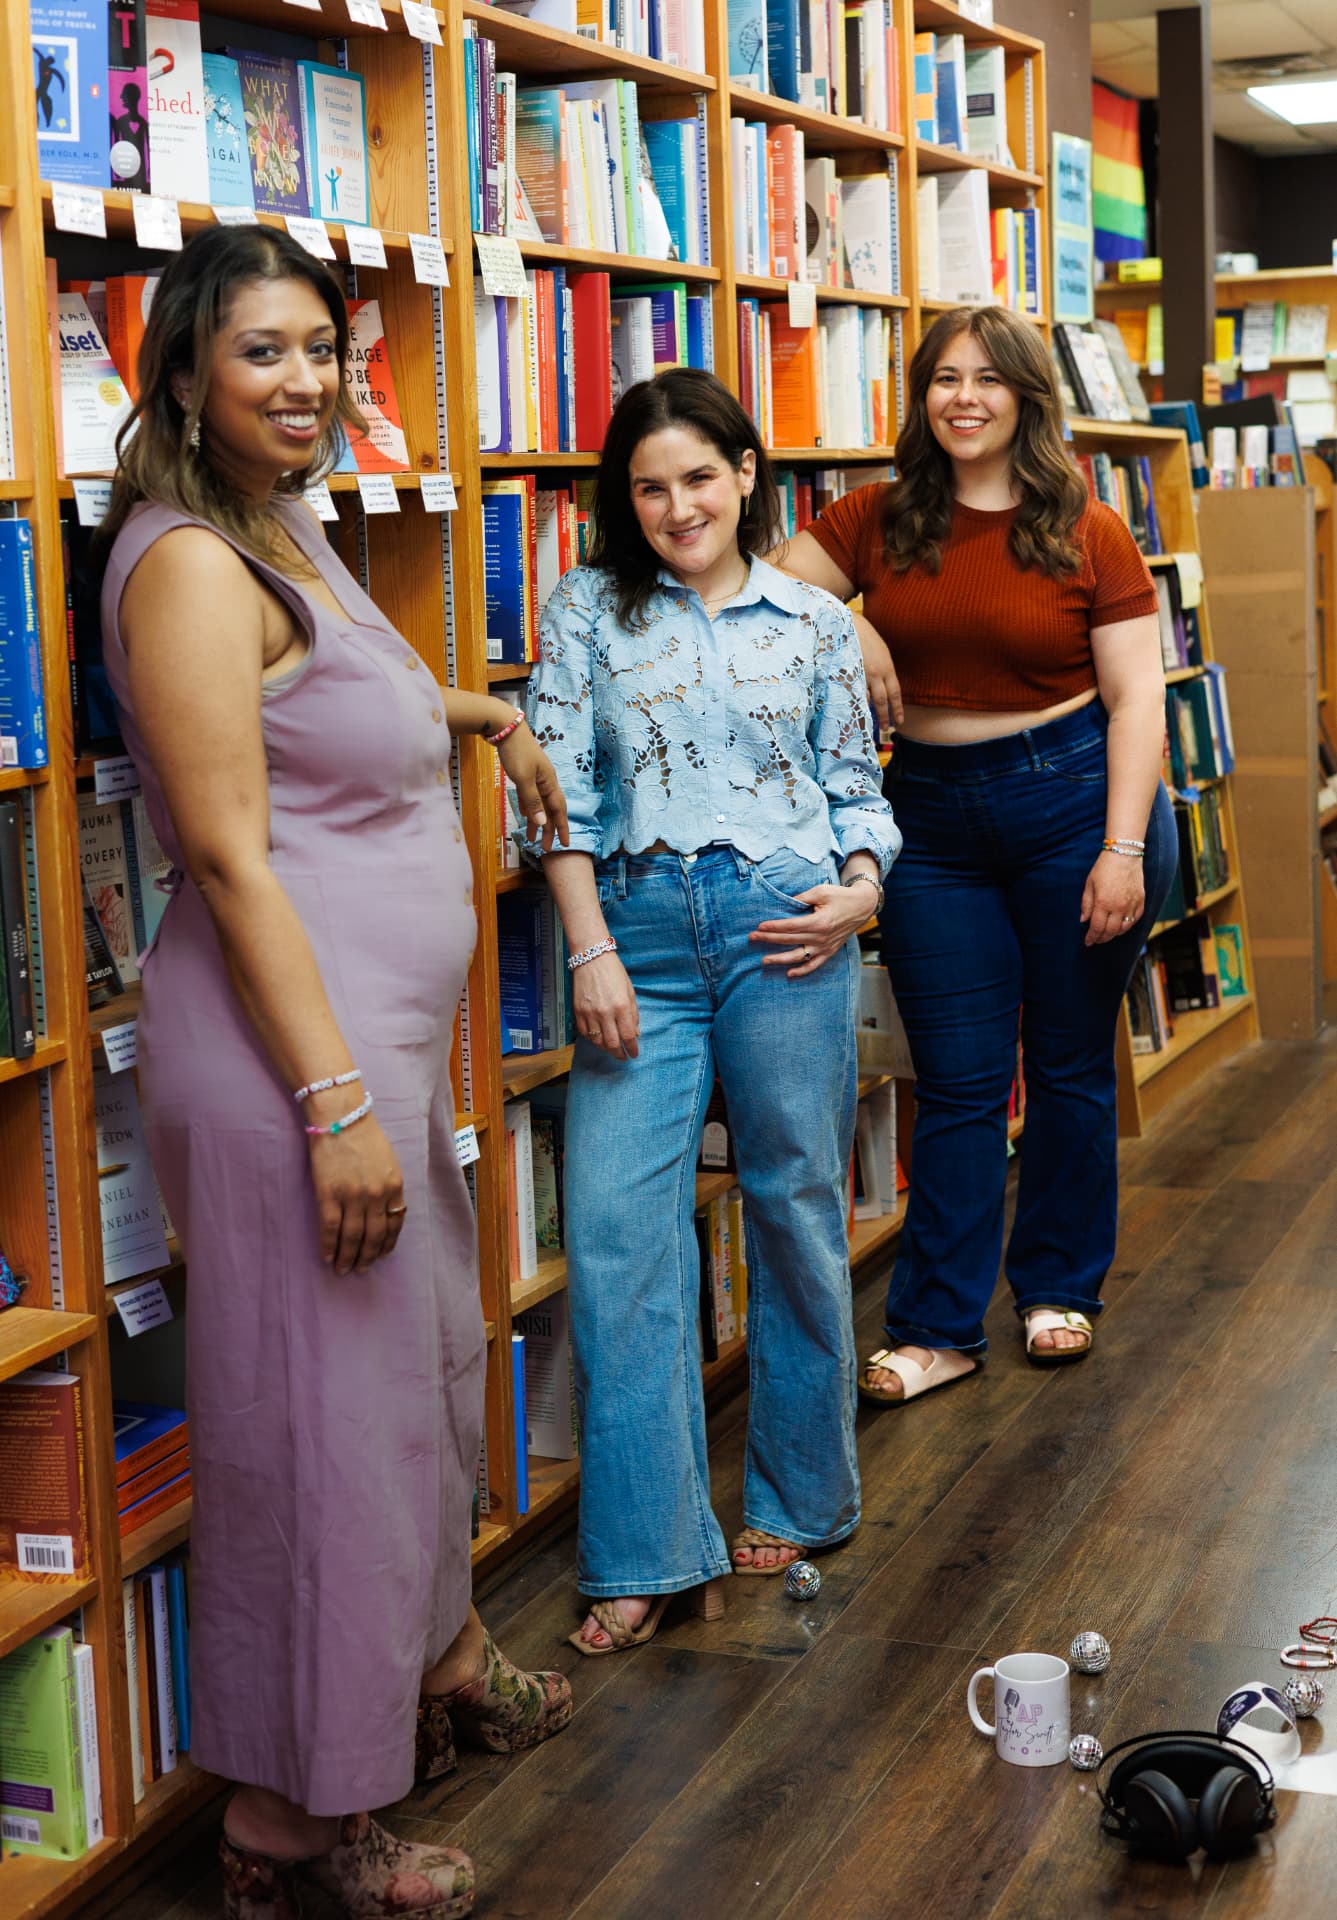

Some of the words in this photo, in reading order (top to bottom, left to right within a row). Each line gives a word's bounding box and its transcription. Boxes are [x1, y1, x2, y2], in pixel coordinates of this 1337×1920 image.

[244, 75, 288, 100] WHAT
[489, 72, 497, 121] Courage
[147, 87, 200, 115] ched.
[207, 146, 241, 164] IGAI
[254, 169, 300, 197] KNOW
[60, 330, 102, 351] dset
[348, 348, 384, 363] RAGE
[356, 370, 372, 384] BE
[355, 390, 387, 406] IKED
[81, 813, 112, 830] AUMA
[80, 846, 122, 866] OVERY
[92, 966, 113, 980] TAYLOR
[103, 1128, 134, 1146] SLOW
[100, 1186, 134, 1205] NIEL
[102, 1208, 150, 1233] NEMAN
[519, 1315, 552, 1337] NISH
[73, 1386, 82, 1428] BARGAIN
[76, 1431, 84, 1460] WITCH
[1016, 1703, 1043, 1724] AP
[999, 1718, 1021, 1744] Taylor
[1025, 1722, 1056, 1744] Swift
